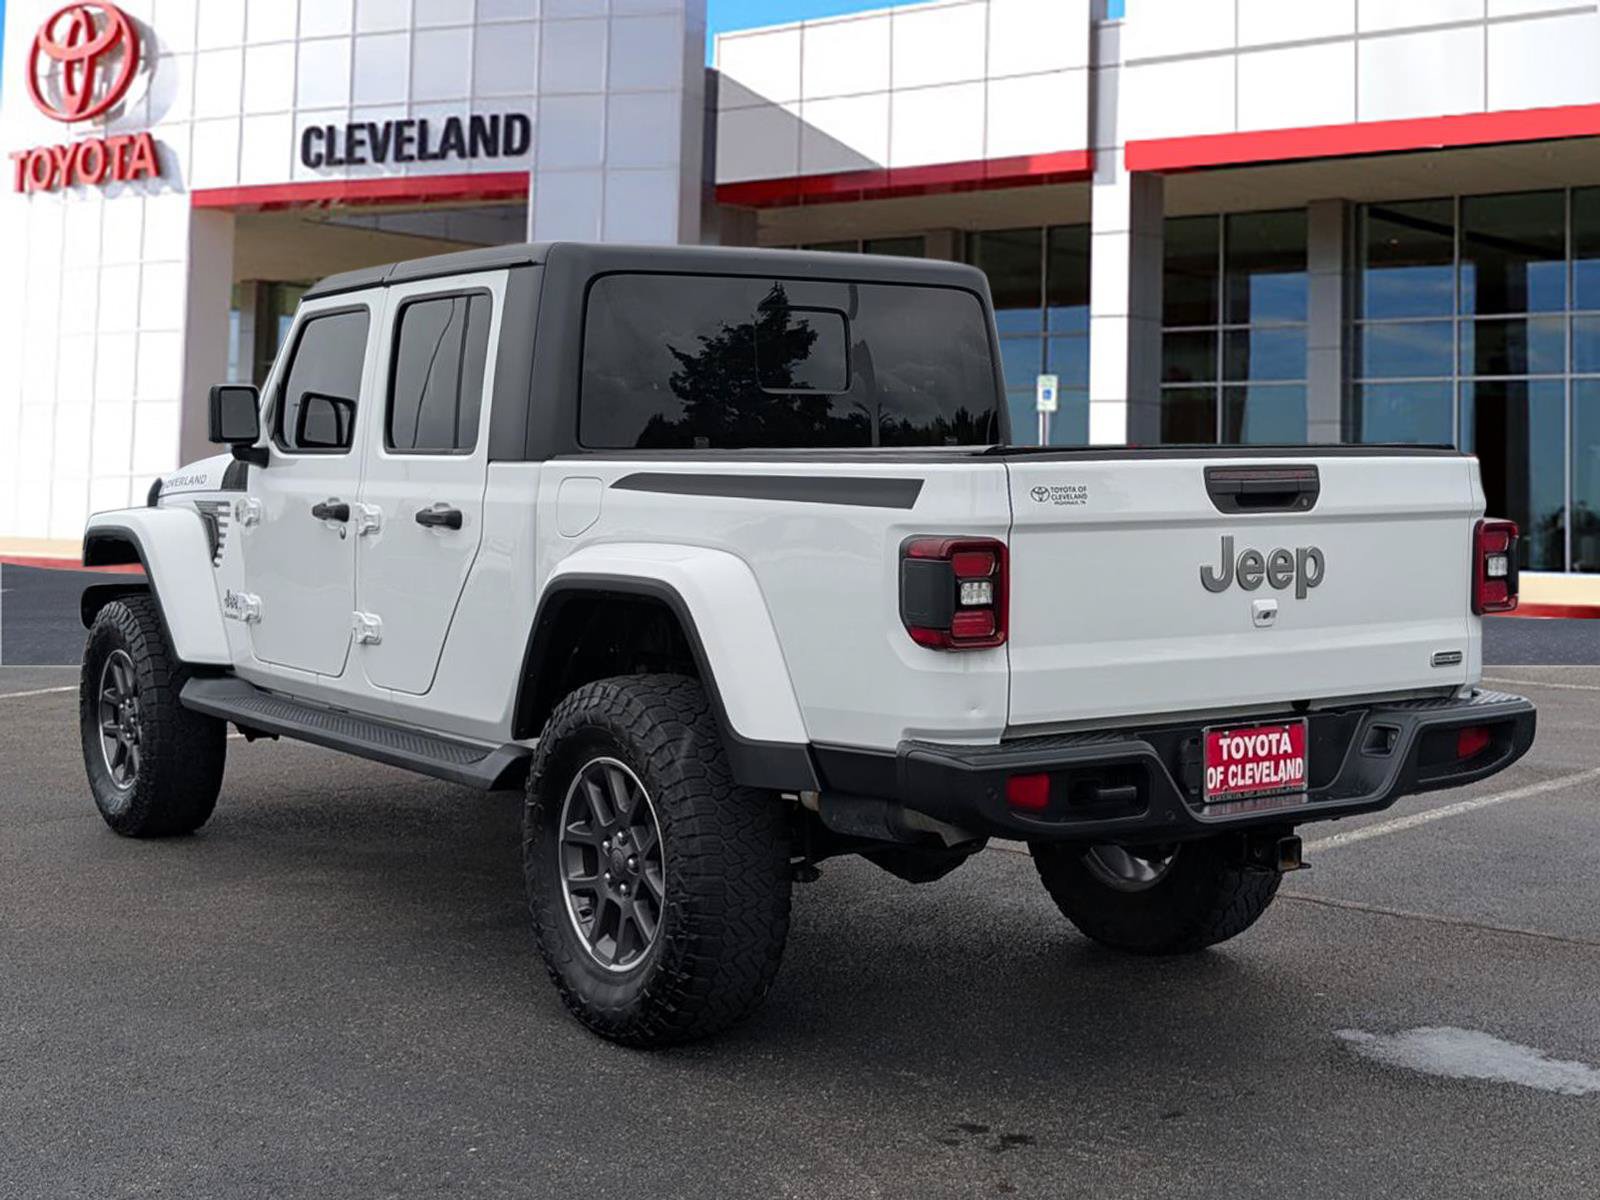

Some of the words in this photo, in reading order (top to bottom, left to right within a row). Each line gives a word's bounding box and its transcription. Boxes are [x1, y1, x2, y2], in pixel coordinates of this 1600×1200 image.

[9, 131, 161, 193] TOYOTA
[300, 113, 531, 169] CLEVELAND
[1200, 535, 1325, 600] Jeep
[1207, 766, 1225, 790] OF
[1227, 757, 1304, 787] CLEVELAND
[1219, 732, 1292, 760] TOYOTA
